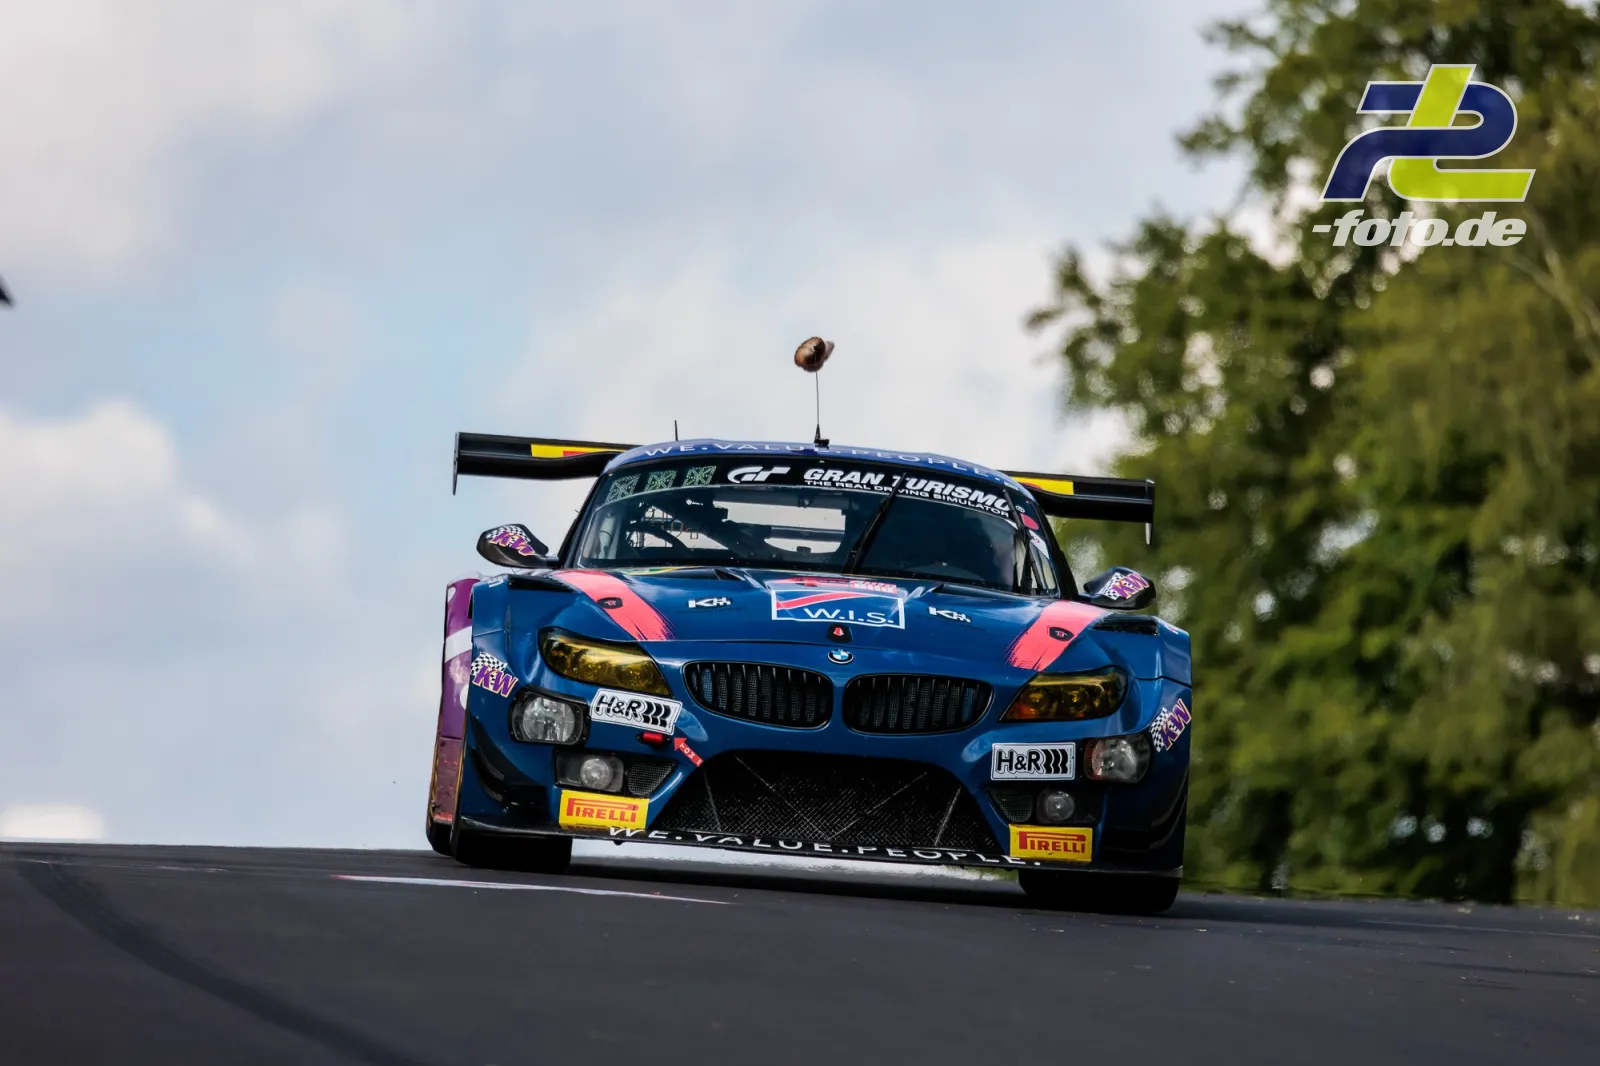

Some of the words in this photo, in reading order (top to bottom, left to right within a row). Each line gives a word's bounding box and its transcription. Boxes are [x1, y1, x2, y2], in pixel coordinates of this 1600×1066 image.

[803, 468, 885, 486] GRAN
[835, 481, 871, 491] REAL
[874, 485, 929, 497] DRVING
[933, 493, 1009, 518] SIMULATOR
[489, 530, 536, 556] KW
[1110, 573, 1150, 599] KW
[804, 608, 895, 624] W.I.S.
[472, 664, 519, 698] KW
[594, 694, 643, 722] H&R
[1159, 698, 1192, 751] KW
[996, 749, 1045, 774] H&R
[567, 797, 640, 823] PIRELLI
[1018, 831, 1087, 854] PIRELLI
